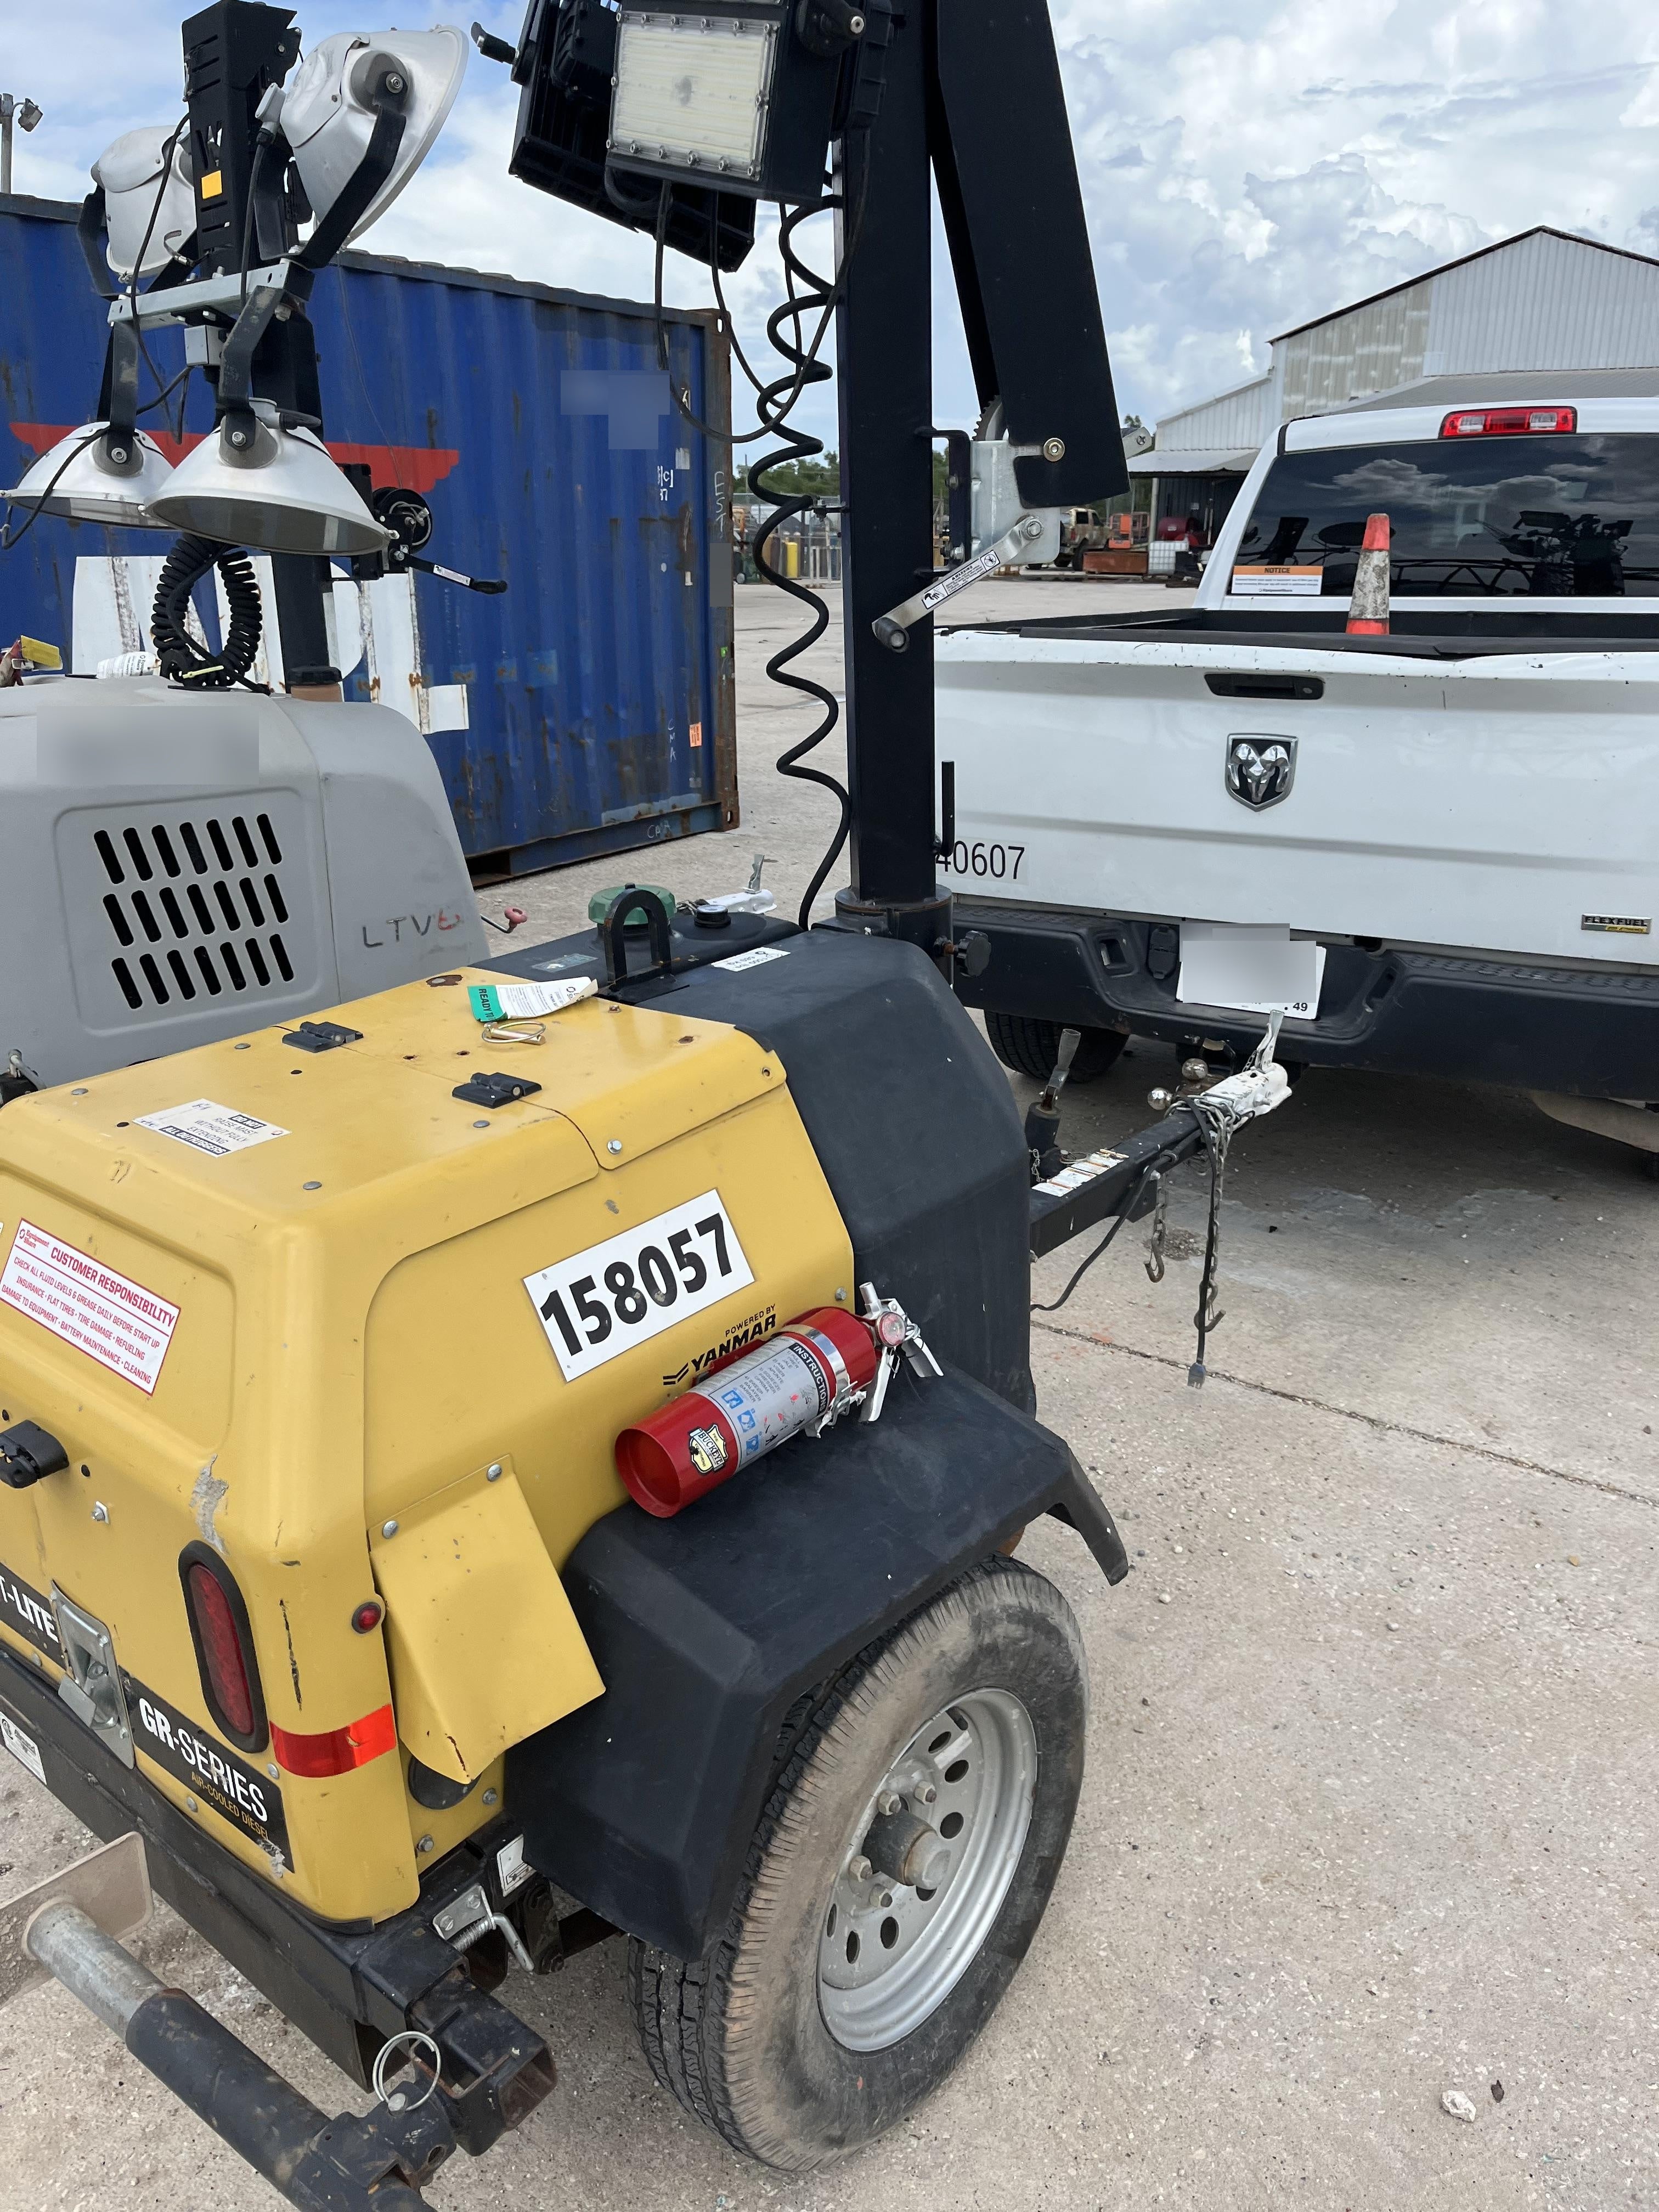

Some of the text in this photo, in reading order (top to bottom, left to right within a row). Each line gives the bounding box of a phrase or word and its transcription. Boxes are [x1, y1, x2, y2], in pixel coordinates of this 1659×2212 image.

[478, 989, 492, 1011] READY
[162, 1126, 227, 1154] ALL OUTRIGGERS
[24, 1237, 36, 1249] Share
[26, 1230, 49, 1248] Equipment
[14, 1256, 160, 1348] CHECK ALL FLUID LEVELS & GREASE DAILY BEFORE START UP
[51, 1246, 175, 1327] CUSTOMER RESPONSIBILITY
[540, 1212, 732, 1356] 158057
[2, 1284, 152, 1384] DAMAGE TO EQUIPMENT BATTERY MAINTENANCE CLEANING
[16, 1276, 145, 1361] INSURANCE FLAT TIRES TIRE DAMAGE REFUELING
[691, 1313, 776, 1372] YANMAR
[725, 1304, 776, 1337] POWERED BY
[793, 1345, 826, 1413] INSTRUCTIONS
[698, 1432, 723, 1465] BUCKEYE
[139, 1698, 268, 1822] GR-SERIES
[192, 1771, 240, 1816] AIR-COOLED
